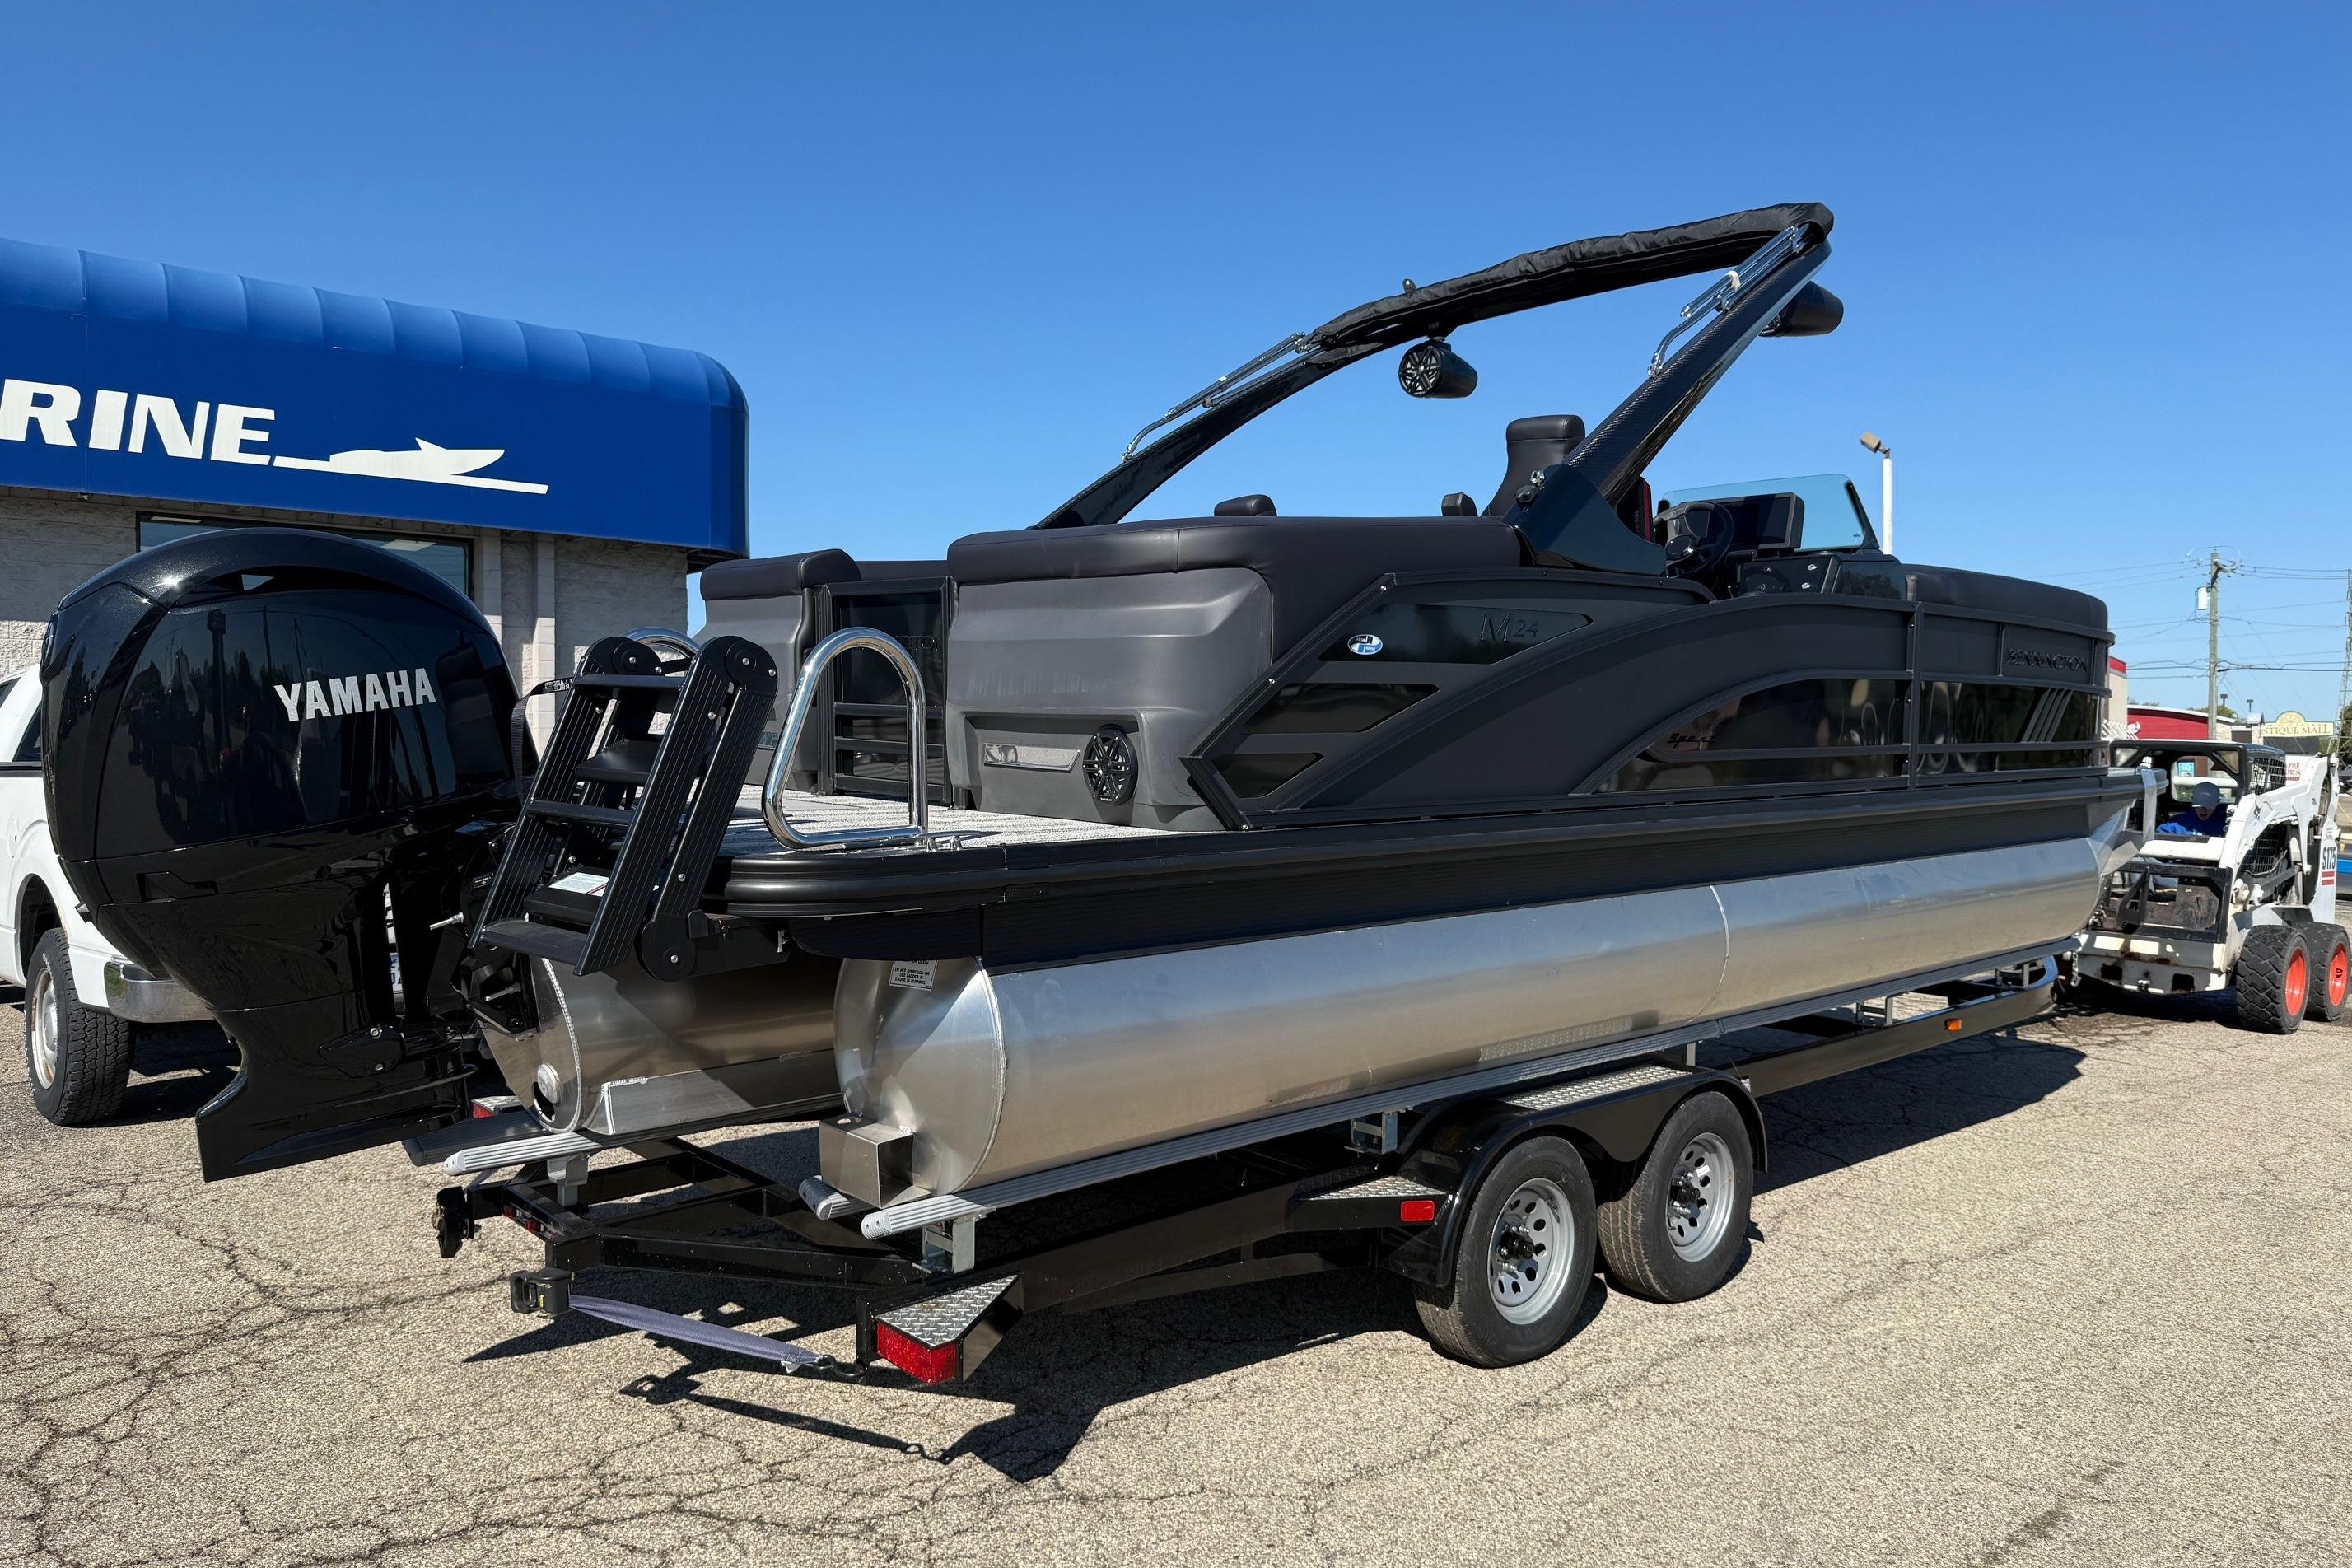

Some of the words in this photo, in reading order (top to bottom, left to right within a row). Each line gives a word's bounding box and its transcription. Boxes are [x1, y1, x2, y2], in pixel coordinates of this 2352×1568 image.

[0, 378, 275, 466] RINE
[274, 668, 436, 722] YAMAHA
[2302, 724, 2330, 735] MALL
[2322, 847, 2336, 870] S175
